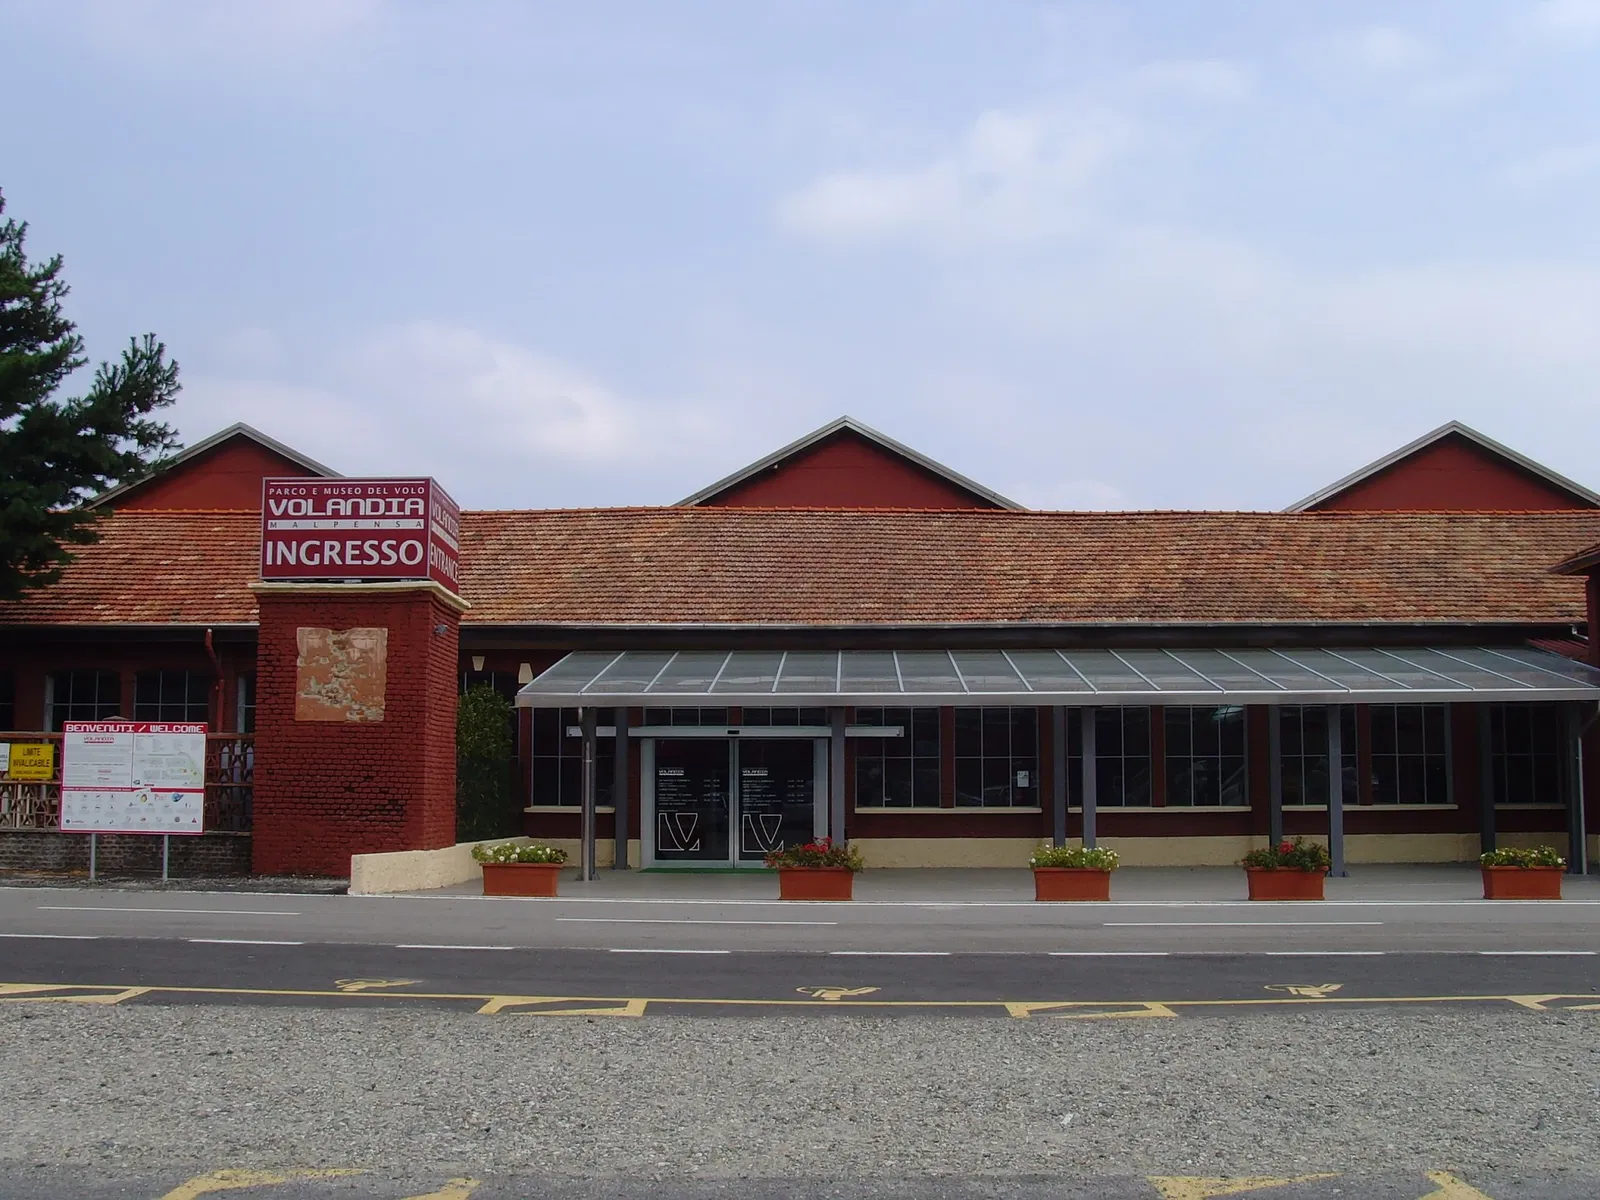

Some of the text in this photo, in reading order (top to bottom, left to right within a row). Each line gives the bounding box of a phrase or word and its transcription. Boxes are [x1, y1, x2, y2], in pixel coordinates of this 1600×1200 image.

[269, 486, 425, 495] PARCO E MUSEO DEL VOLO
[268, 497, 425, 516] VOLANDIA
[269, 521, 422, 529] MALPENSA
[266, 539, 424, 566] INGRESSO
[430, 542, 459, 584] ENTRANCE
[65, 724, 135, 733] BENVENUTI
[149, 725, 204, 733] WELCOME
